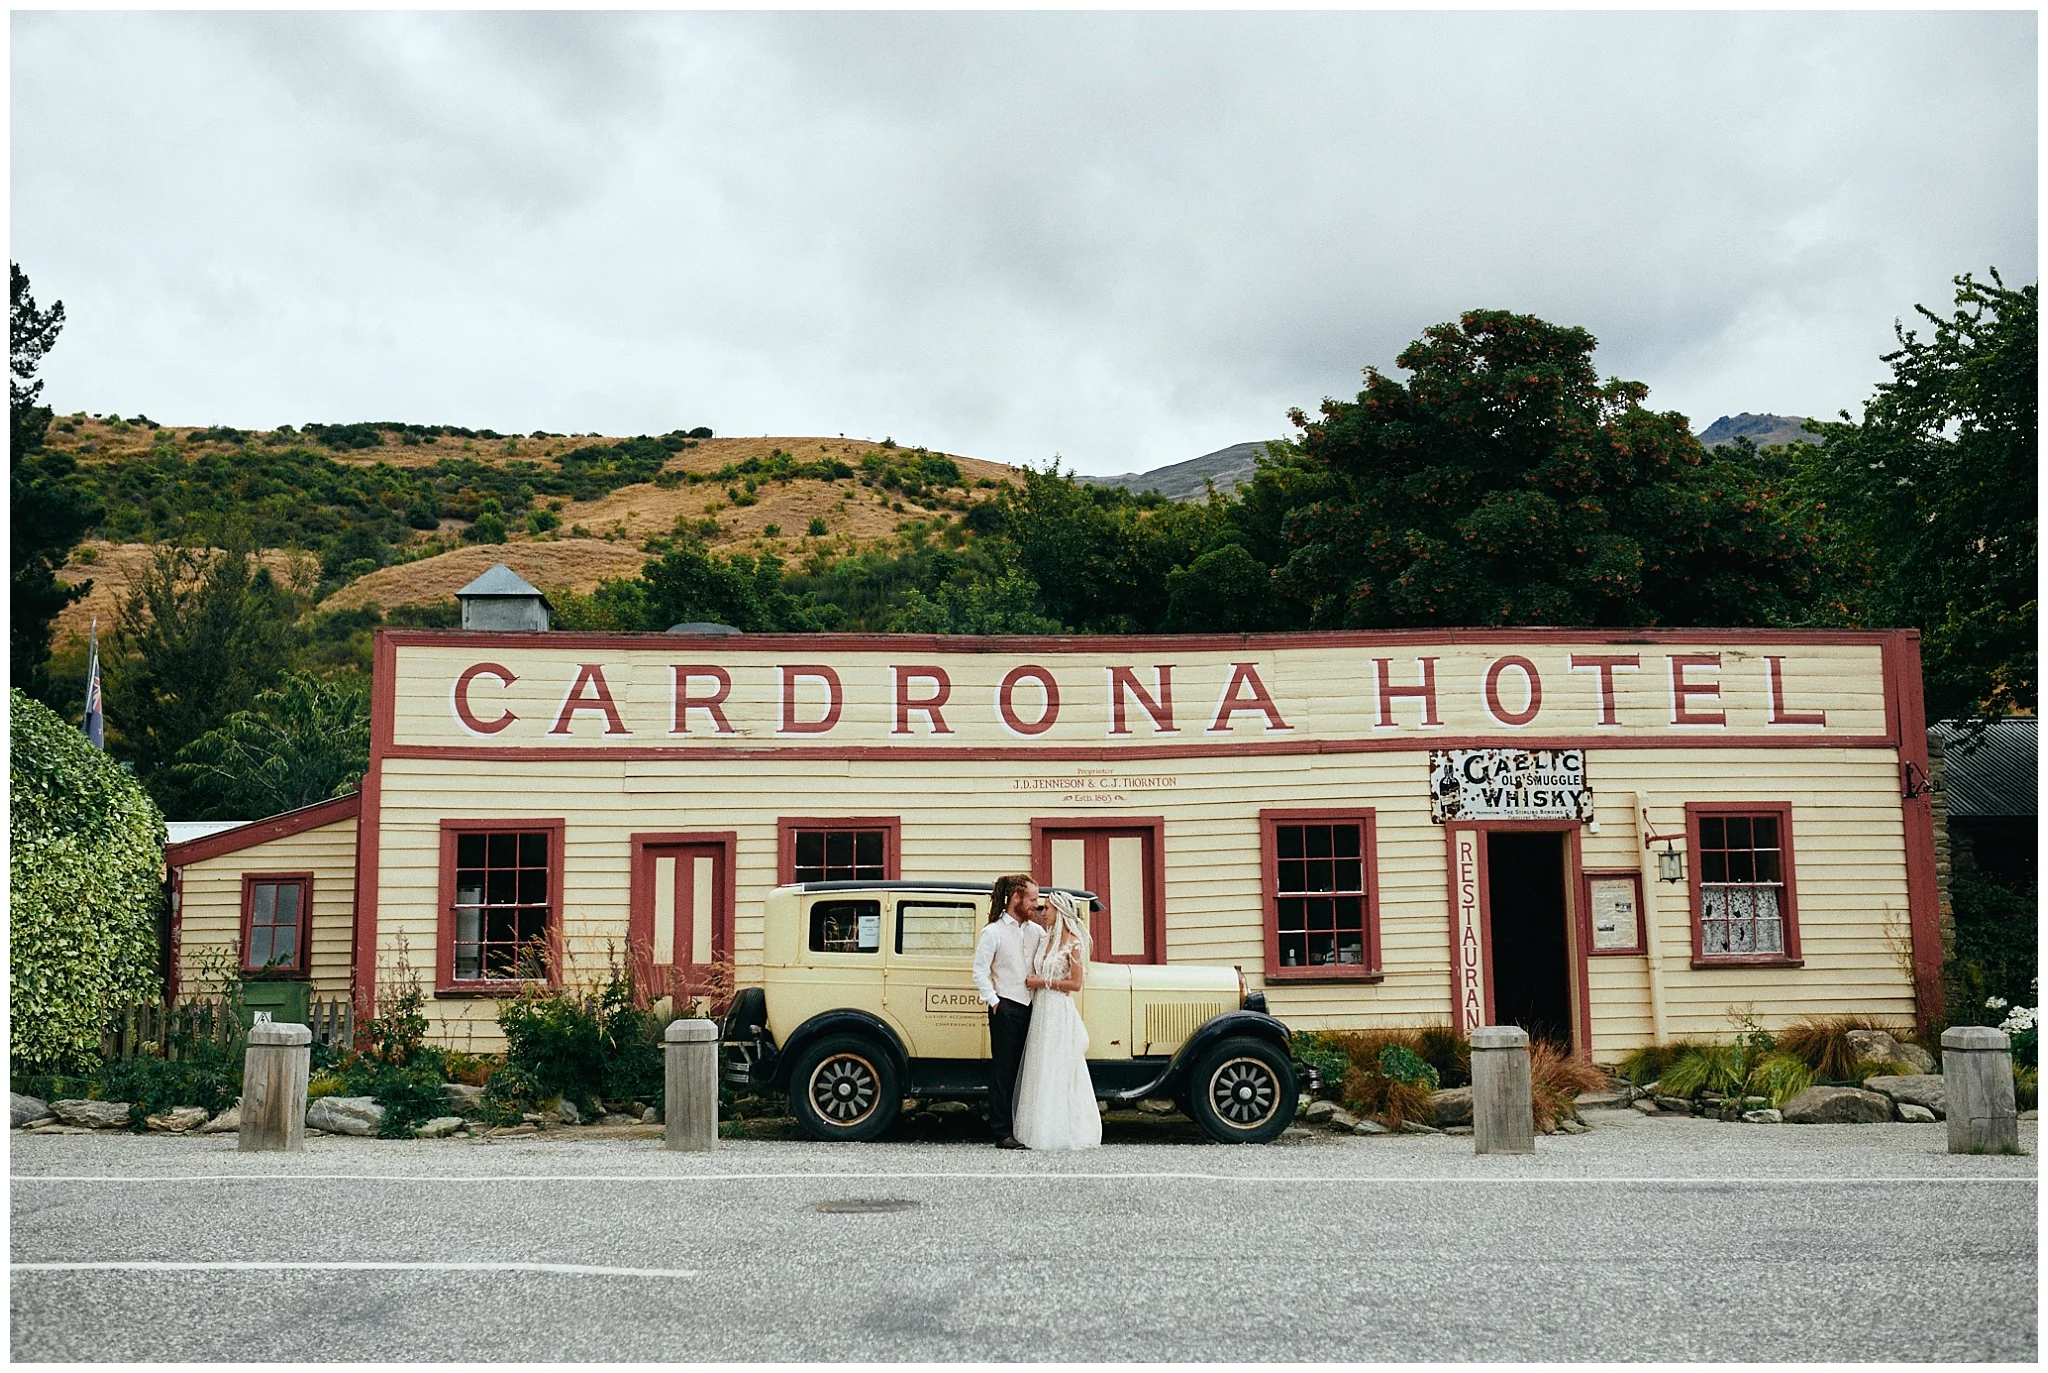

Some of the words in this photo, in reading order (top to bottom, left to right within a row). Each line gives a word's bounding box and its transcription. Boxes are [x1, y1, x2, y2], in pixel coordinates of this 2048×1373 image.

[452, 661, 1296, 737] CARDRONA
[1371, 654, 1827, 730] HOTEL
[1463, 754, 1580, 784] GAELIC
[1087, 779, 1096, 788] &
[1122, 777, 1177, 788] THORNTON
[1527, 774, 1586, 786] SMUGGLE
[1481, 787, 1582, 808] WHISKY
[1460, 842, 1480, 1031] RESTAURAN
[931, 995, 988, 1005] CARDRO
